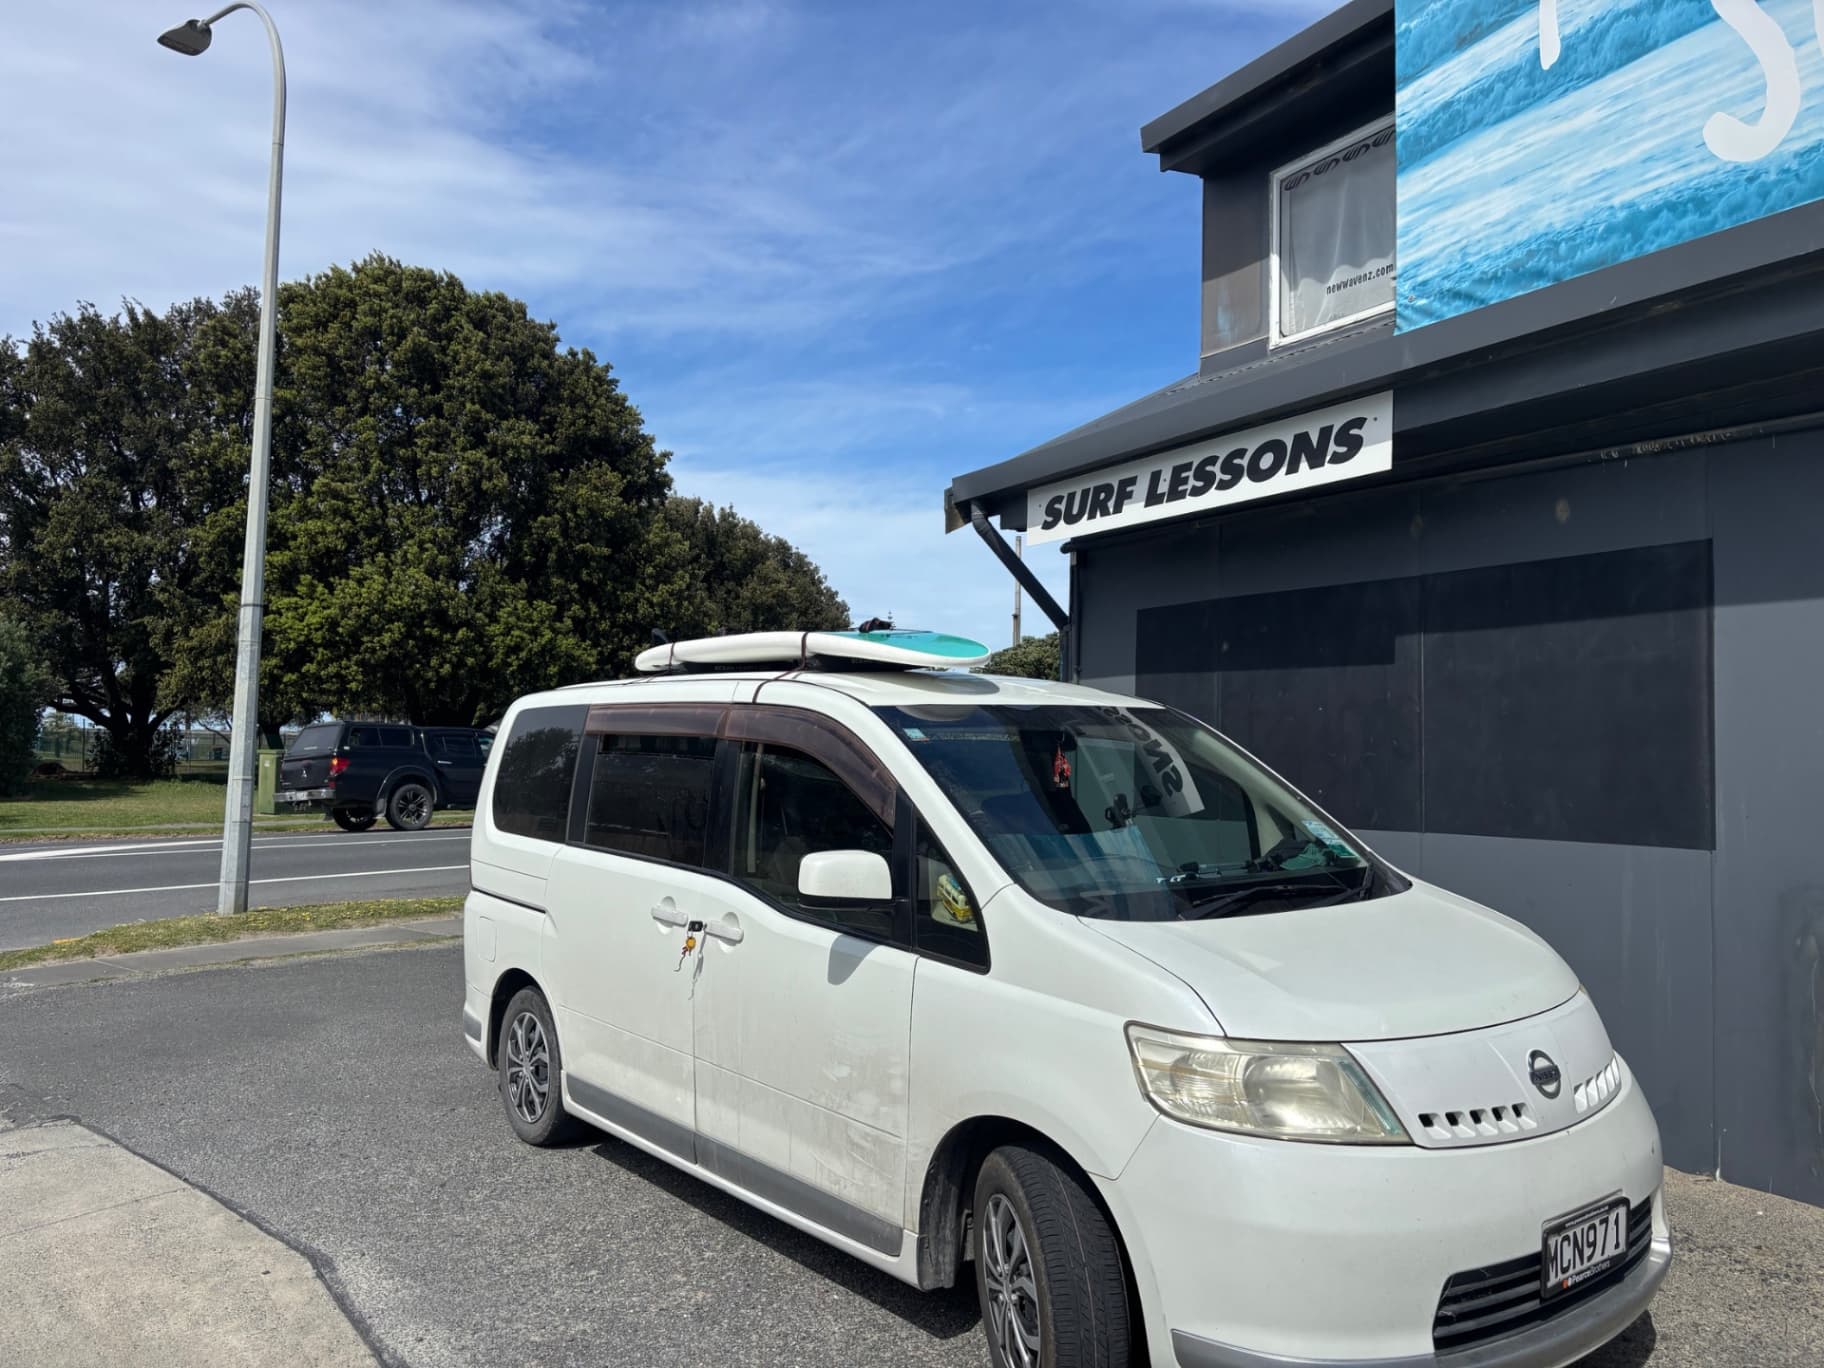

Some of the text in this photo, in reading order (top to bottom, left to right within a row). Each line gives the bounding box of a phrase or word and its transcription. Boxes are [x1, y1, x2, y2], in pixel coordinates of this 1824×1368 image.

[1326, 263, 1394, 296] newwavenz.com
[1041, 416, 1367, 530] SURF LESSONS
[1547, 1211, 1620, 1283] MCN971
